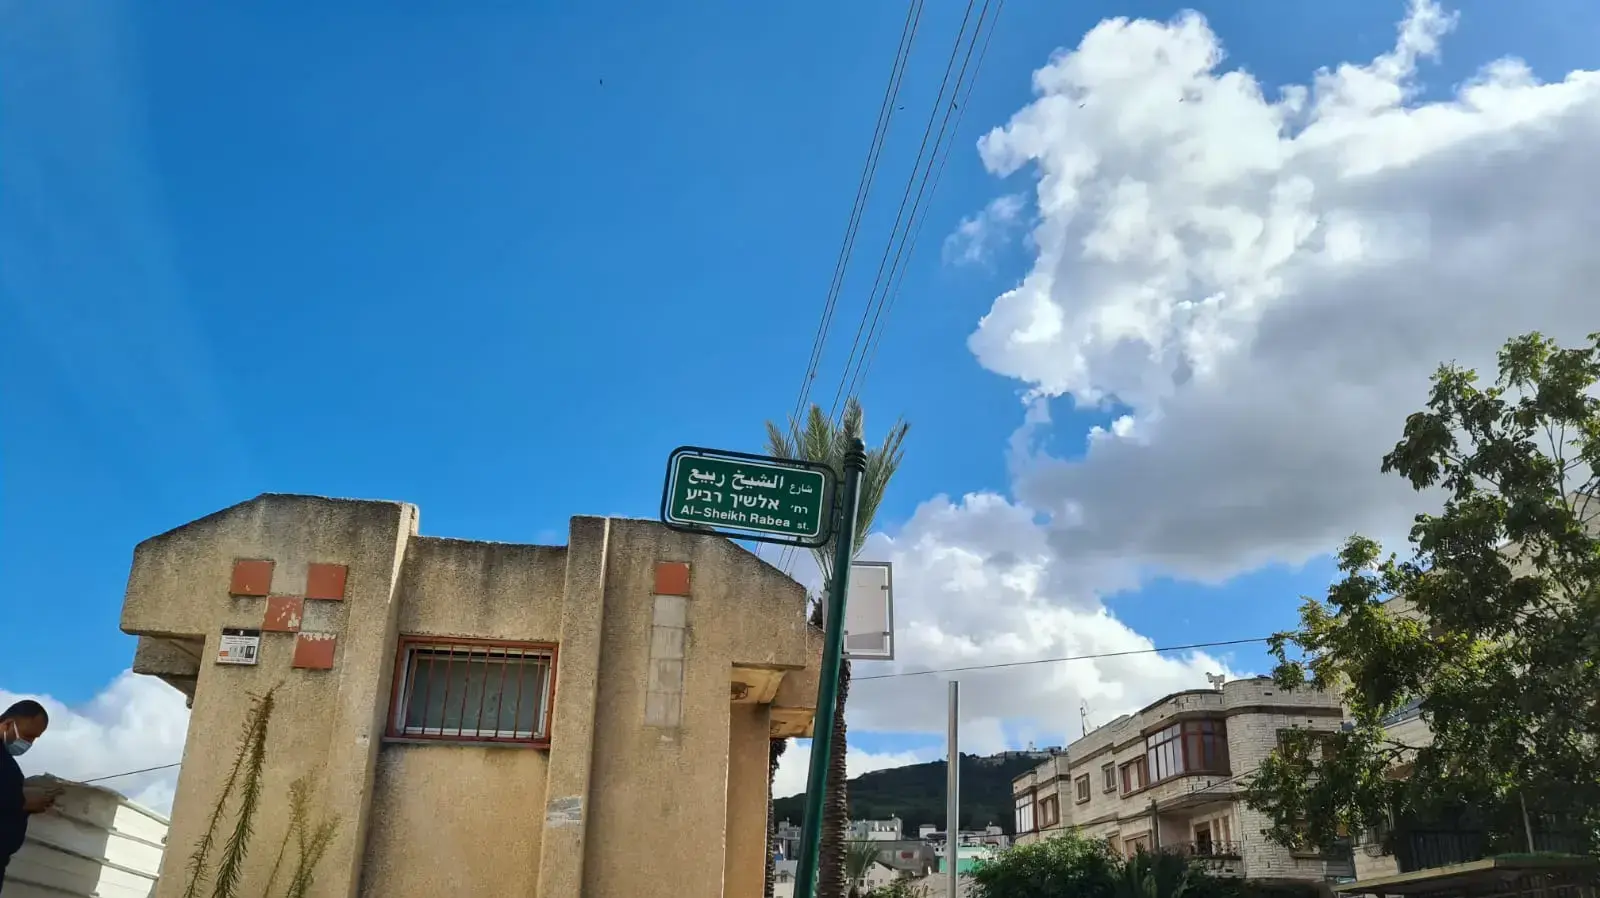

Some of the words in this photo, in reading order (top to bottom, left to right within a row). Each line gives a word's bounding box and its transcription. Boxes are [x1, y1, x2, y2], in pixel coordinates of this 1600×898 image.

[688, 468, 725, 487] ربيع
[731, 469, 784, 490] الشيخ
[685, 488, 722, 503] רביע
[789, 481, 813, 495] شارع
[729, 493, 780, 511] אלשיך
[680, 505, 747, 522] Al-Sheikh
[750, 513, 791, 528] Rabea
[797, 522, 809, 531] st.
